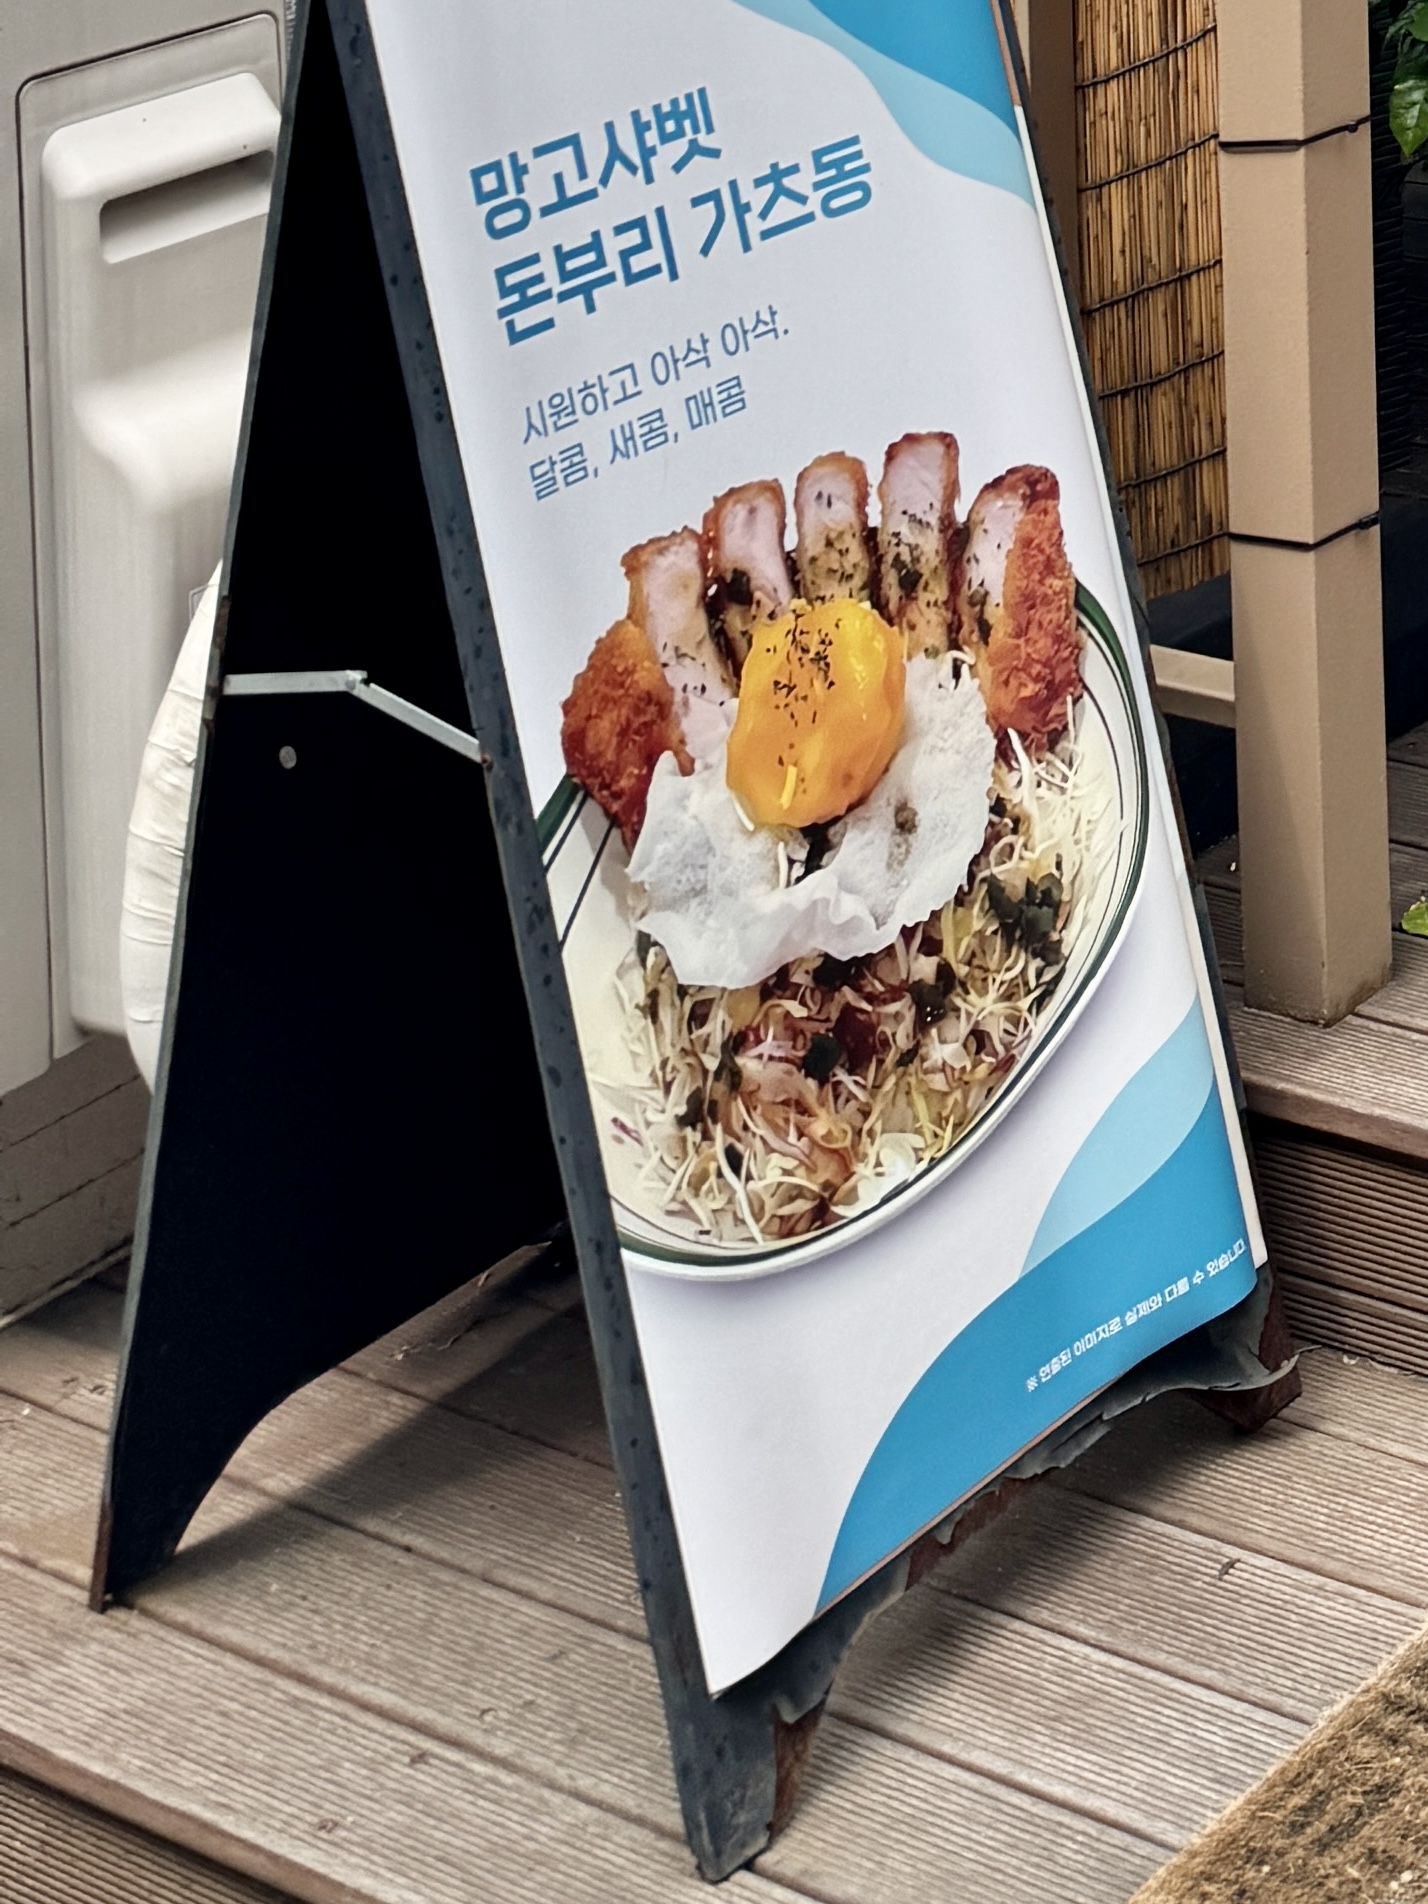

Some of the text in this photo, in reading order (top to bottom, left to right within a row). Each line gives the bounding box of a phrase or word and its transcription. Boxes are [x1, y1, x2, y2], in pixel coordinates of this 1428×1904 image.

[468, 86, 723, 242] 망고샤벳
[493, 134, 875, 346] 돈부리 가츠동
[521, 304, 790, 445] 시원하고 아삭 아삭.
[527, 375, 748, 503] 달콤, 새콤, 매콤
[1073, 1316, 1123, 1356] 이미지로
[1193, 1270, 1205, 1285] 수
